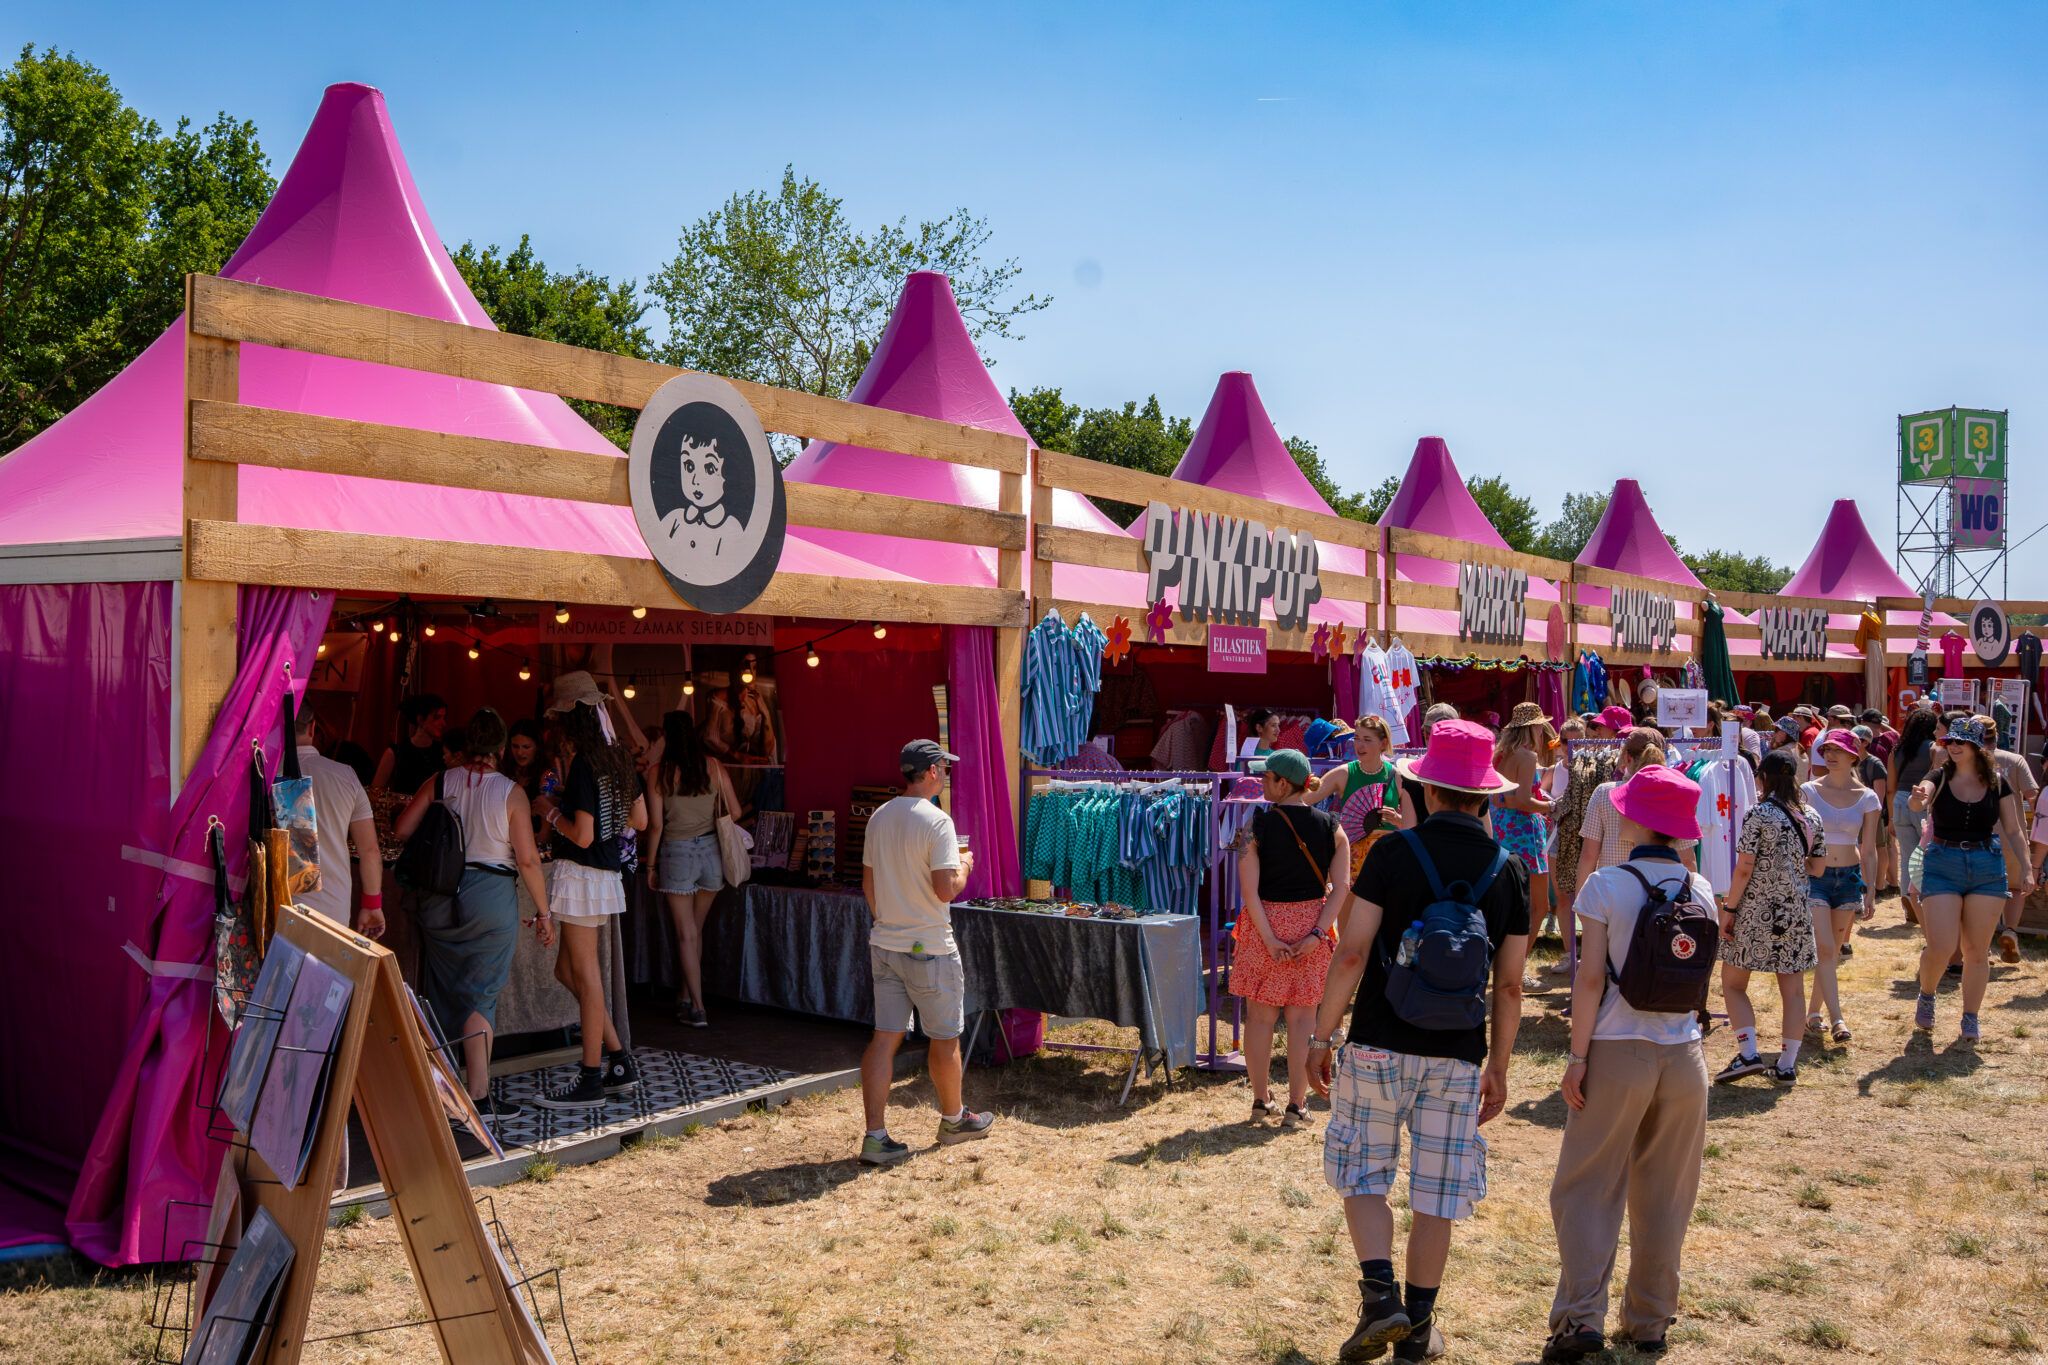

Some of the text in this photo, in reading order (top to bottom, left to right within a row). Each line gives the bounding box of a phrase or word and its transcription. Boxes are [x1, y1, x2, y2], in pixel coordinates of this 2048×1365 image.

[1918, 427, 1934, 451] 3
[1973, 426, 1988, 448] 3
[1961, 494, 1998, 531] WC
[1144, 501, 1321, 629] PINKPOP
[1459, 560, 1528, 644] MARKT
[546, 621, 767, 635] HANDMADE ZAMAK SIERADEN
[1610, 585, 1676, 653] PINKPOP
[1759, 605, 1829, 660] MARKT
[1213, 636, 1263, 656] ELLASTIEK
[1222, 655, 1252, 663] AMSTERDAM
